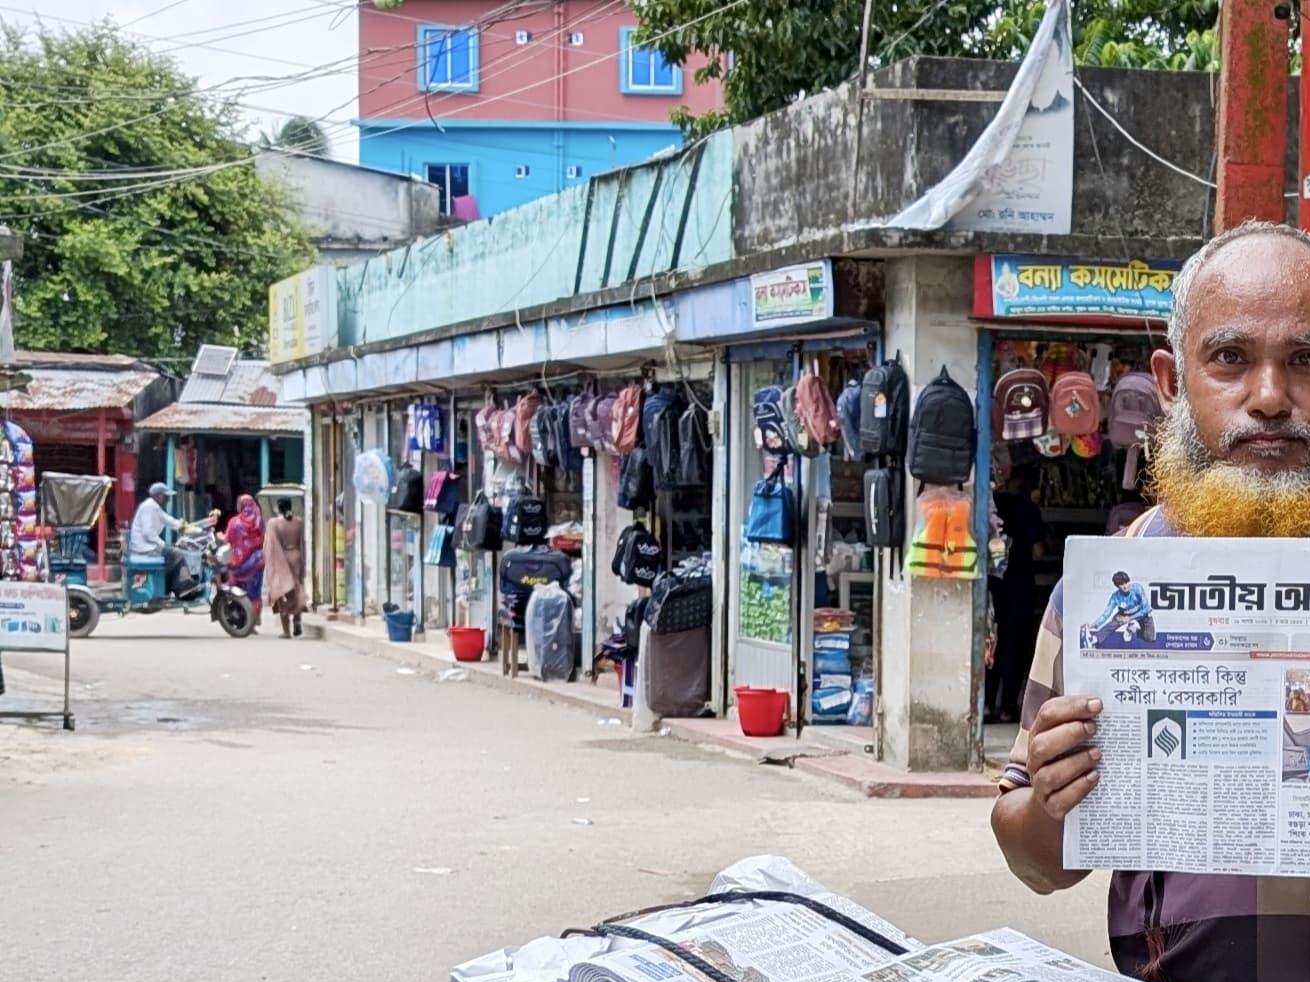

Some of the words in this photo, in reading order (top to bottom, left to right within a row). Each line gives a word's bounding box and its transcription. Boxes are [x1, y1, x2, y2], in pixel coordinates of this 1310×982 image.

[1018, 265, 1062, 291] বন্যা
[1069, 259, 1179, 293] কসমেটিক
[1149, 575, 1267, 611] জাতীয়
[1111, 667, 1150, 684] ব্যাংক
[1157, 665, 1210, 685] সরকারি
[1216, 666, 1247, 685] কিন্তু
[1114, 685, 1156, 704] কর্মীরা
